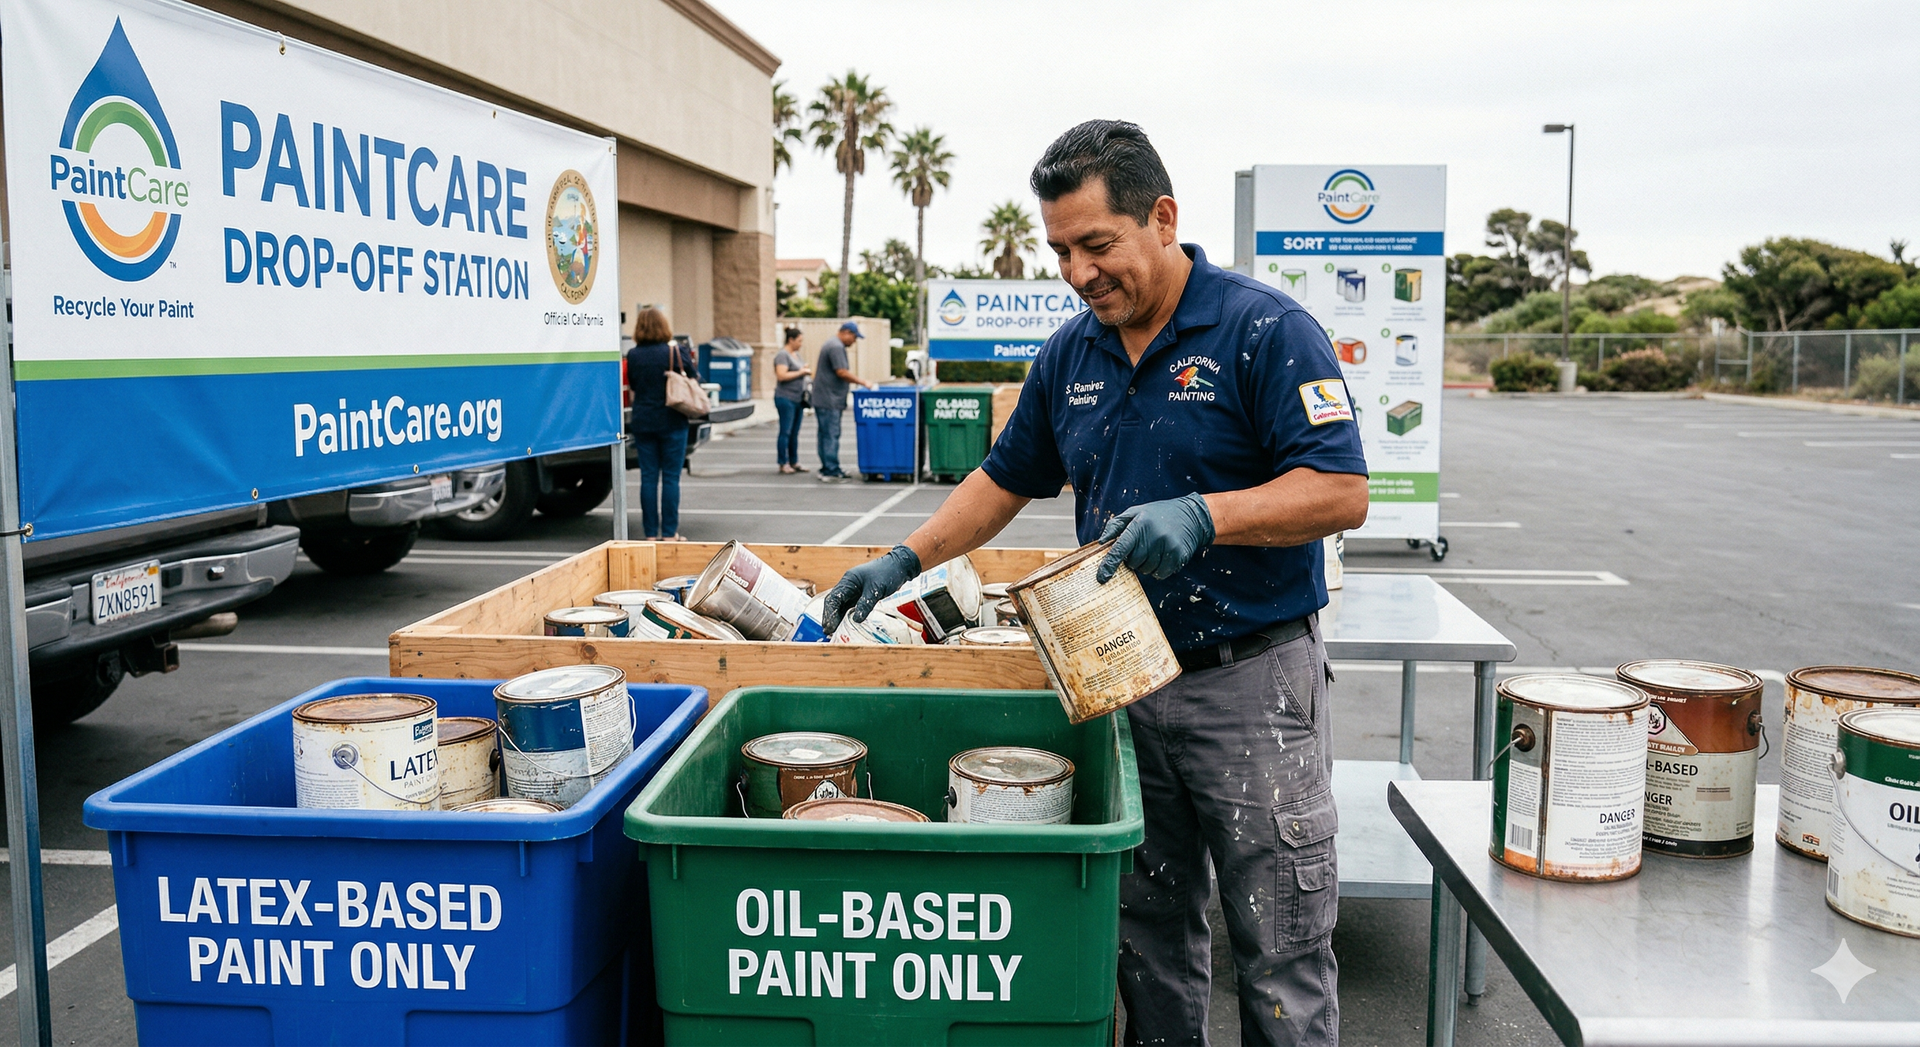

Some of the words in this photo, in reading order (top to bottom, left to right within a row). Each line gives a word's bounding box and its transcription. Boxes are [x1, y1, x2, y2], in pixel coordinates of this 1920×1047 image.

[221, 99, 528, 240] PAINTCARE
[1283, 236, 1325, 251] SORT
[223, 226, 413, 296] DROP-OFF
[423, 250, 530, 300] STATION
[53, 295, 116, 320] Recycle
[120, 298, 155, 317] Your
[159, 300, 194, 319] Paint
[976, 316, 1044, 328] DROP-OFF
[1048, 316, 1069, 328] ST
[1169, 355, 1221, 375] CALIFORNIA
[1073, 380, 1105, 394] Ramirez
[1168, 391, 1216, 401] PAINTING
[858, 397, 913, 409] LATEX-BASED
[935, 398, 980, 409] OIL-BASED
[1068, 393, 1098, 406] Painting
[861, 408, 886, 418] PAINT
[886, 408, 908, 419] ONLY
[933, 408, 957, 419] PAINT
[957, 408, 981, 420] ONLY
[293, 395, 502, 457] PaintCare.org
[98, 582, 157, 619] ZXN8591
[1095, 630, 1136, 657] DANGER
[1599, 808, 1635, 824] DANGER
[157, 875, 503, 933] LATEX-BASED
[735, 887, 1013, 942] OIL-BASED
[187, 936, 335, 988] PAINT
[349, 939, 477, 992] ONLY
[727, 948, 877, 999] PAINT
[891, 951, 1024, 1002] ONLY
